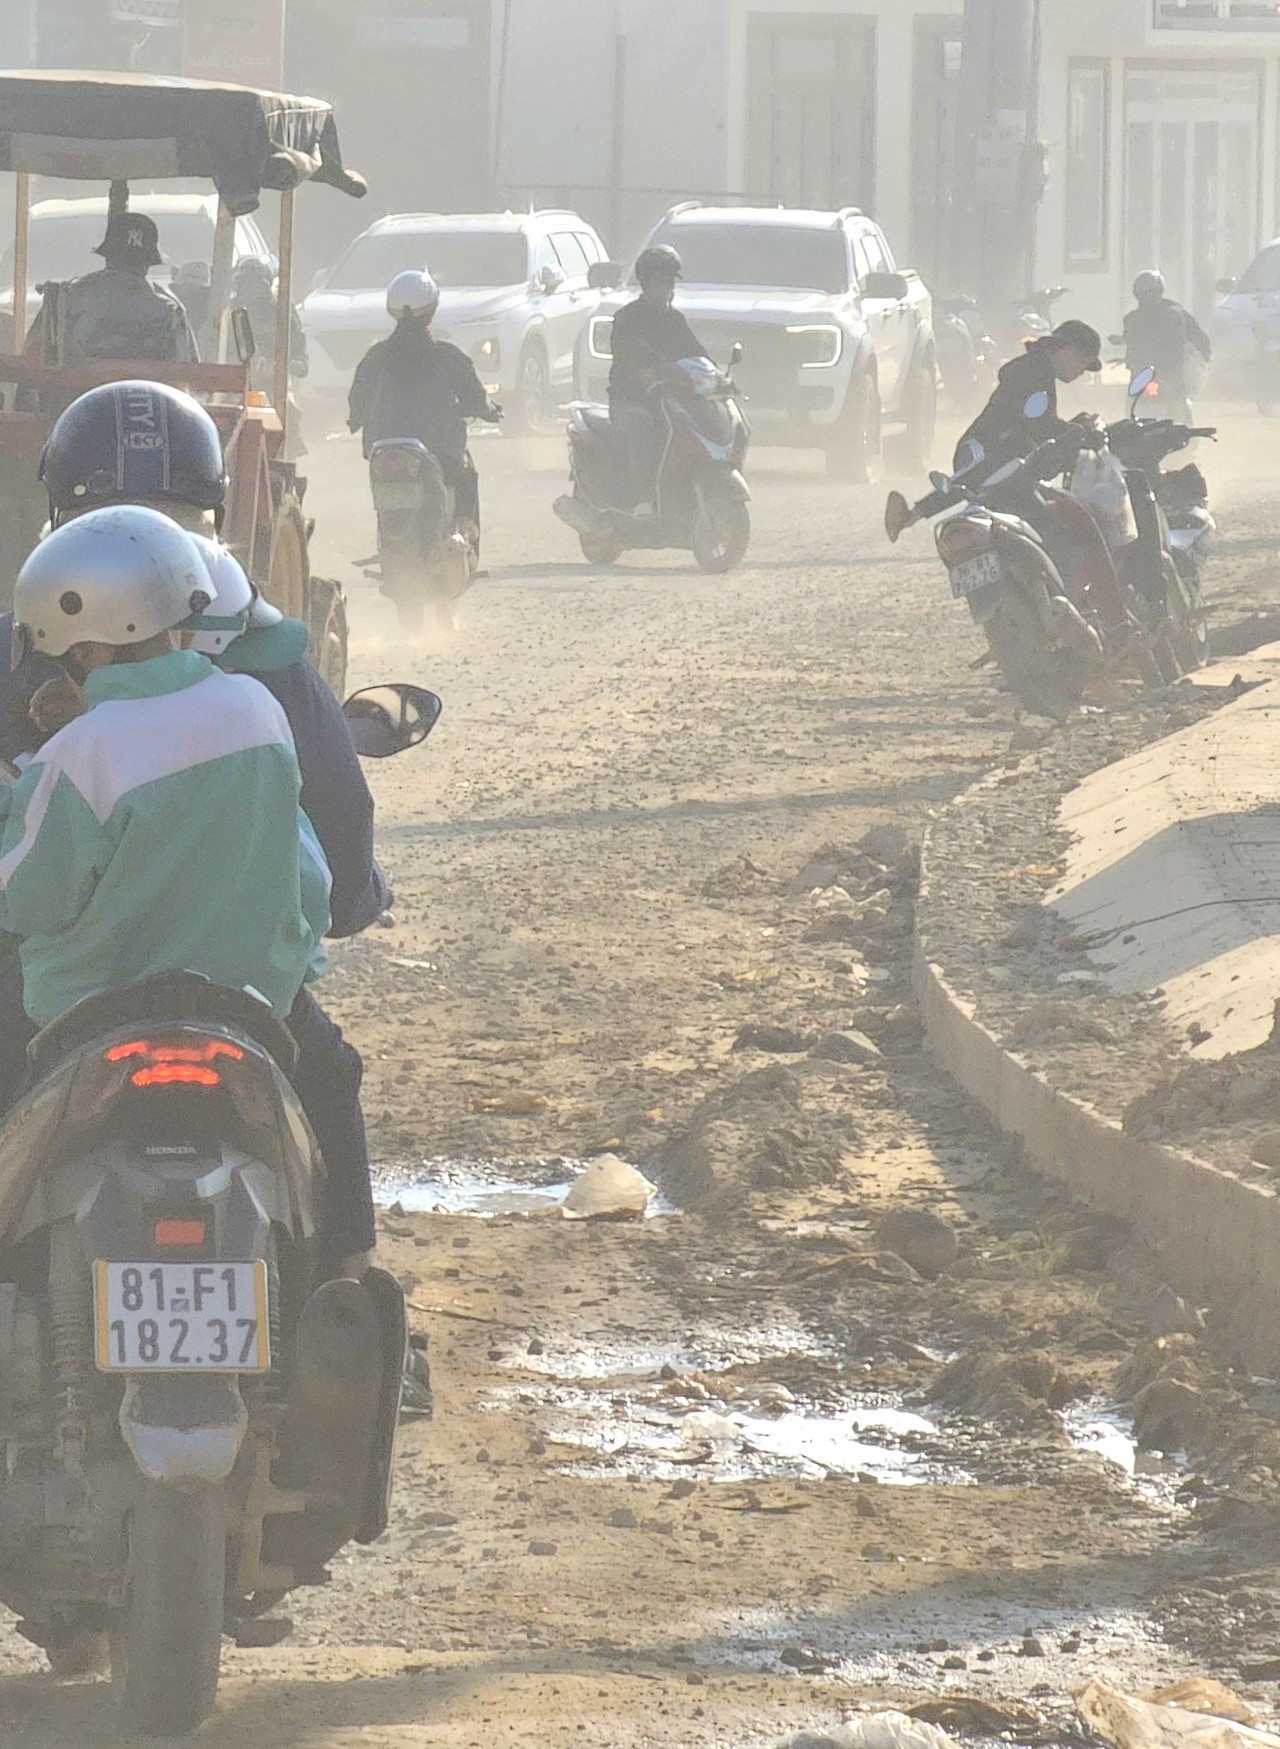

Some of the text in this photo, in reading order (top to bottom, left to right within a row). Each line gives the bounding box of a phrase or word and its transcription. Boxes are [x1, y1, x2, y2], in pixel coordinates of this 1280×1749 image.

[145, 1146, 197, 1155] HONDA
[122, 1267, 237, 1311] 81-F1
[110, 1318, 258, 1363] 182.37
